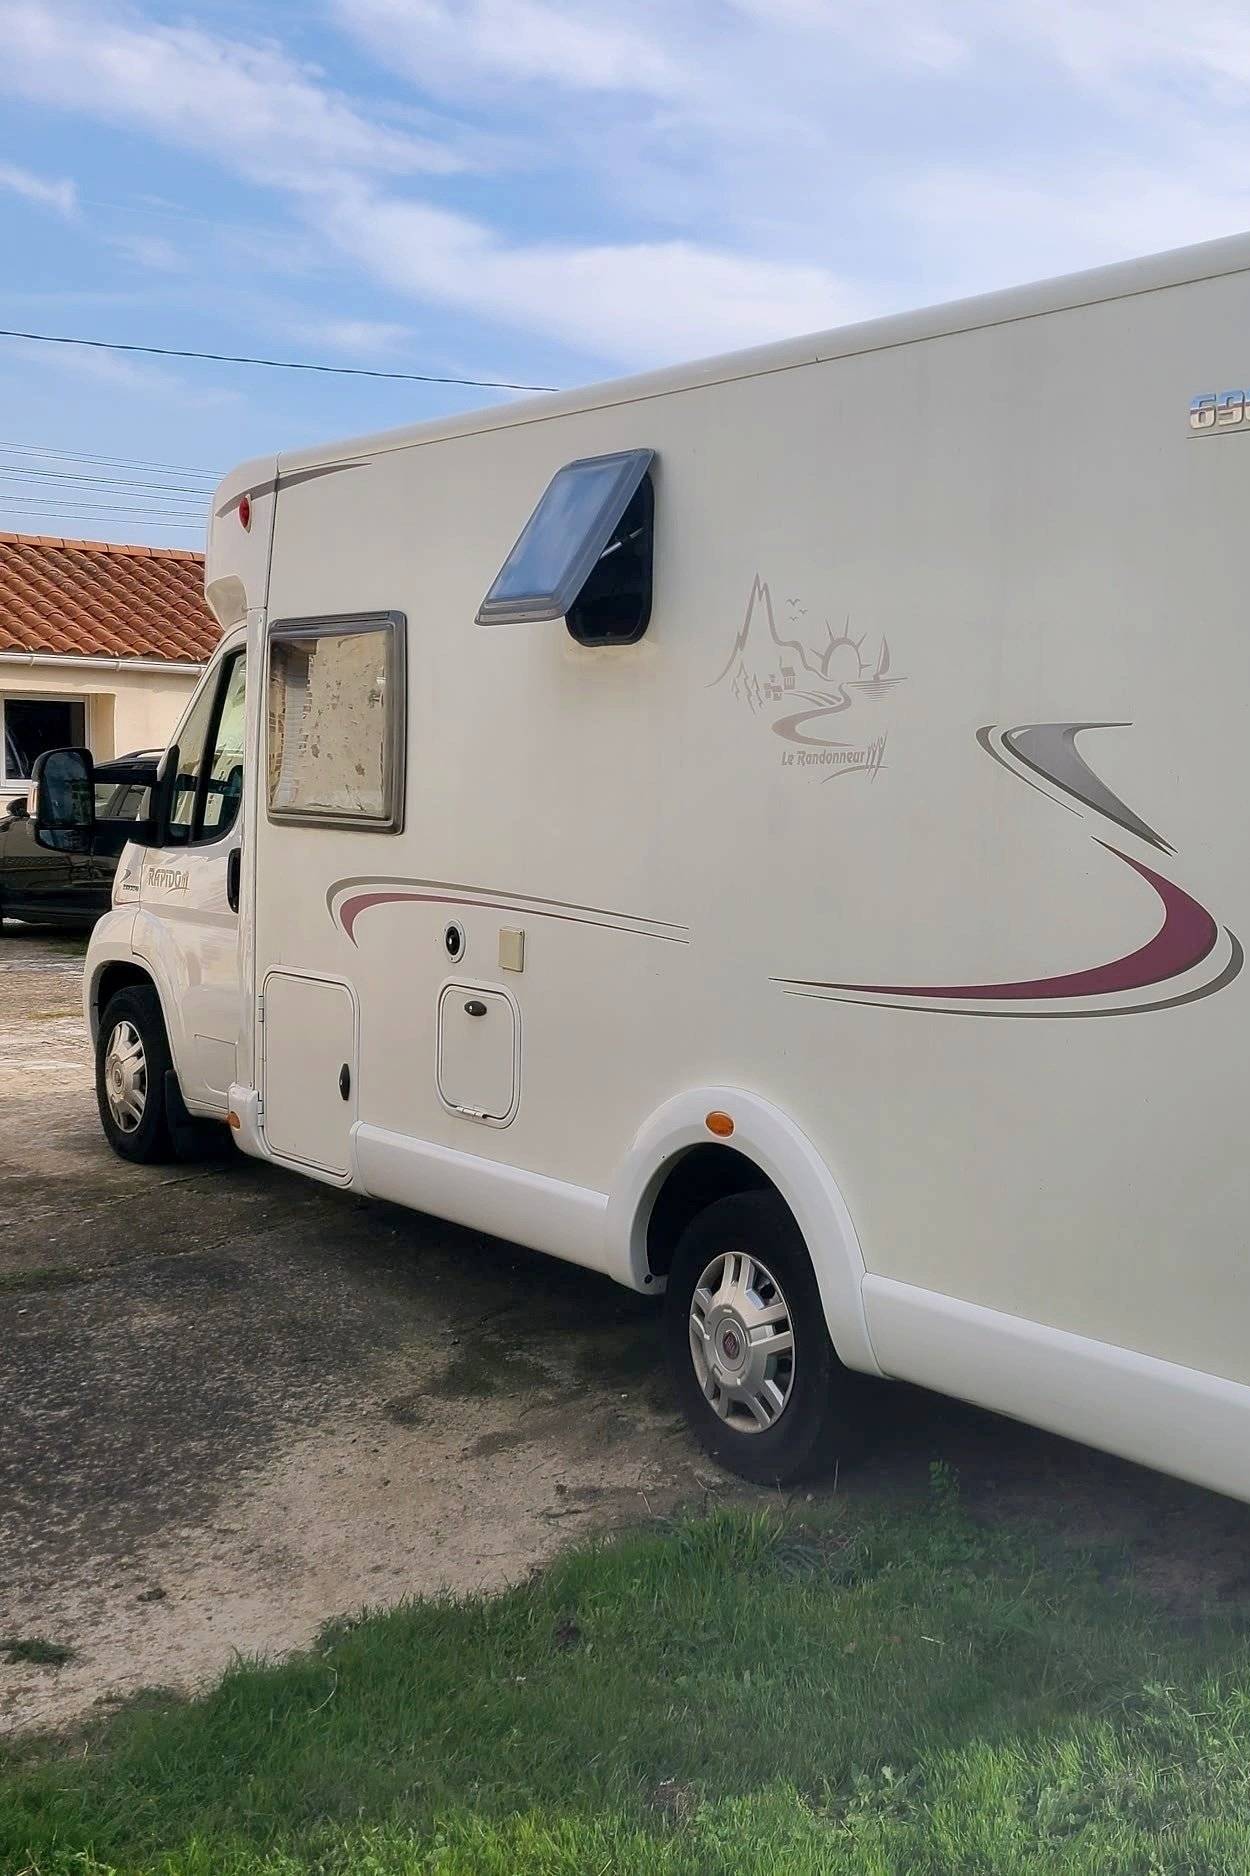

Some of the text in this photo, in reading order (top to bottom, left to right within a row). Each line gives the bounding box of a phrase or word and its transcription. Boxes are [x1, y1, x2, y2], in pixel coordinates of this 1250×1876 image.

[781, 749, 866, 767] Le Randonneur
[148, 867, 182, 889] RAPIDO
